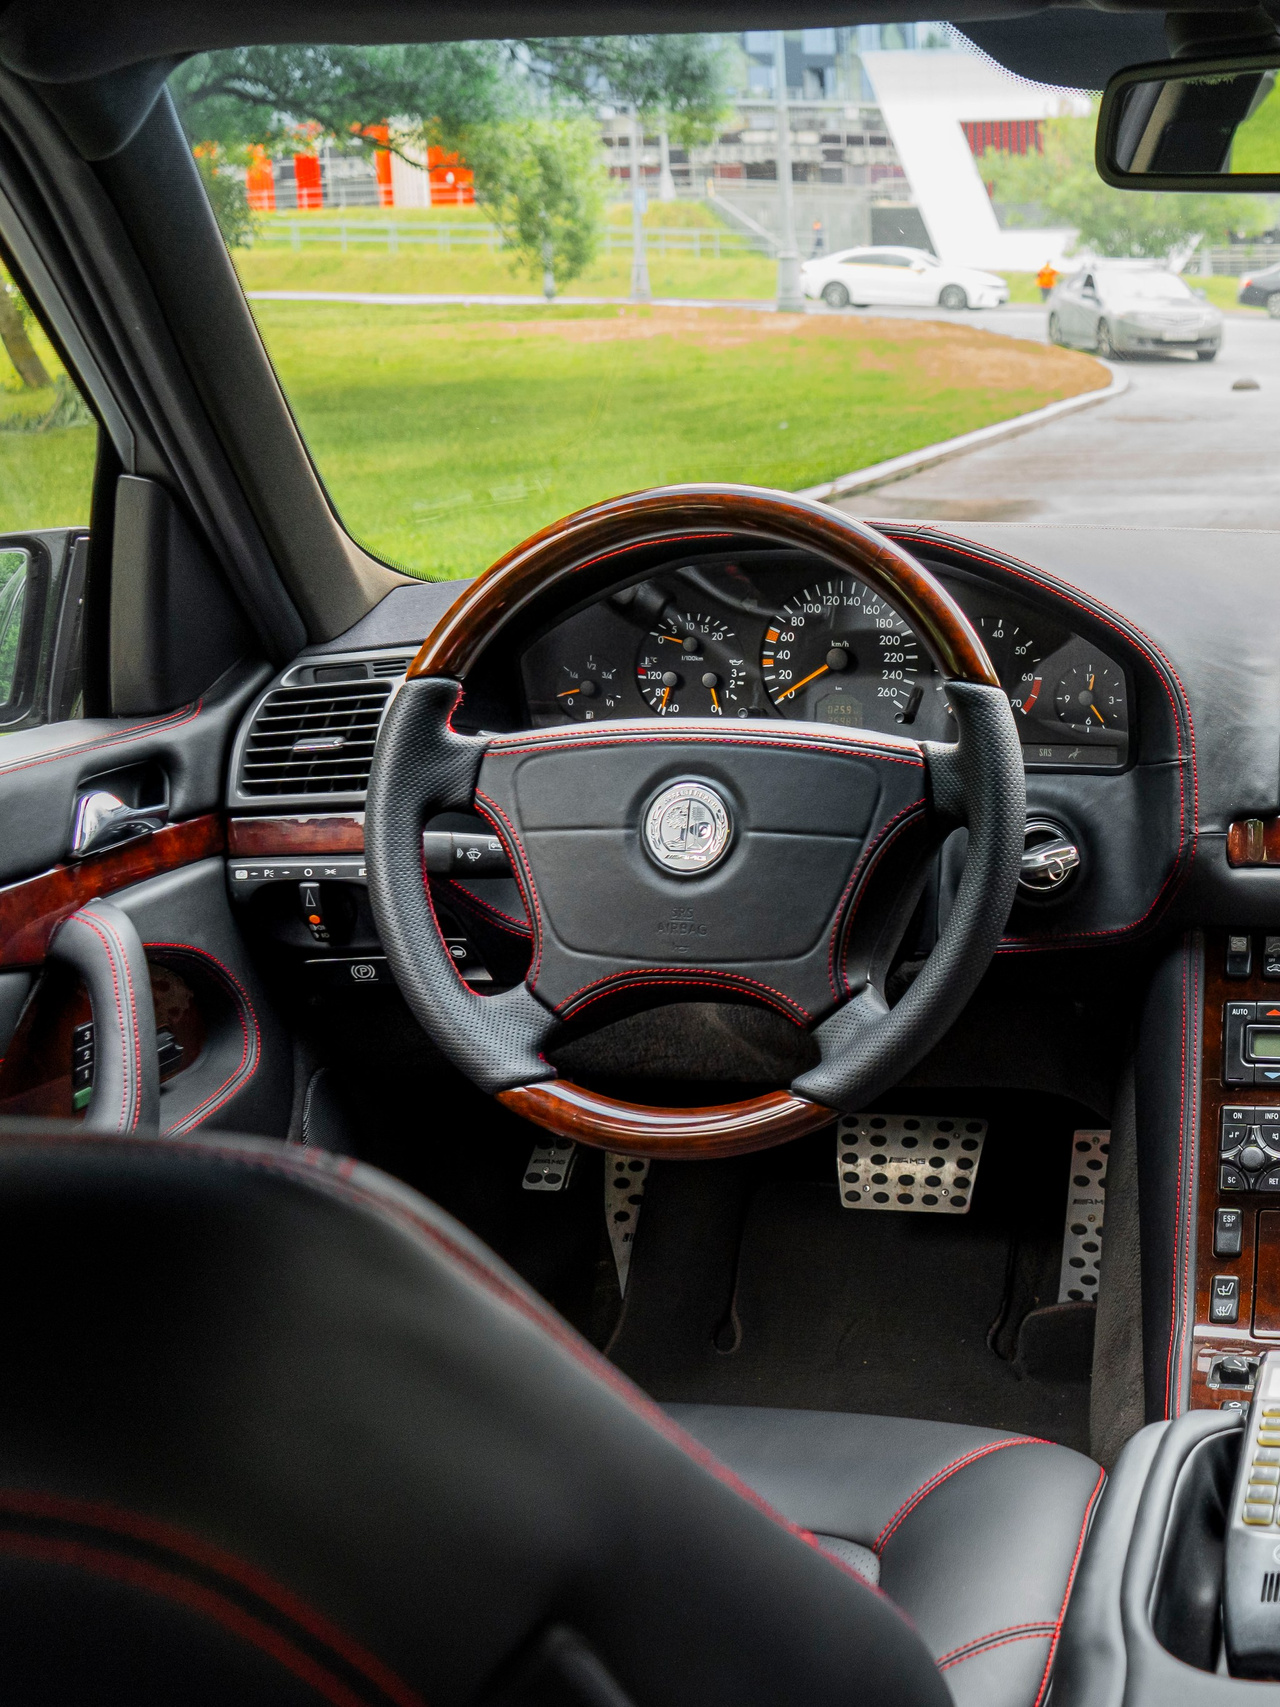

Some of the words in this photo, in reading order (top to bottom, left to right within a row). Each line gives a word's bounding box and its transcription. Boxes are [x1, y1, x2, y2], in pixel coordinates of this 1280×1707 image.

[823, 596, 840, 606] 120
[843, 597, 861, 607] 140
[803, 603, 821, 614] 100
[863, 606, 880, 615] 160
[686, 622, 695, 631] 10
[791, 617, 805, 627] 80
[876, 618, 893, 629] 180
[672, 625, 677, 634] 5
[700, 625, 709, 634] 15
[992, 629, 1004, 639] 40
[658, 635, 664, 645] 0
[712, 632, 723, 641] 20
[780, 632, 795, 643] 60
[879, 635, 900, 646] 200
[831, 640, 849, 648] km/h
[777, 649, 791, 660] 40
[1015, 647, 1027, 656] 50
[884, 652, 904, 663] 220
[648, 671, 662, 680] 120
[732, 669, 737, 677] 3
[779, 669, 793, 680] 20
[882, 670, 903, 681] 240
[1022, 673, 1033, 682] 60
[1086, 673, 1094, 682] 12
[730, 680, 735, 688] 2
[655, 687, 666, 697] 80
[726, 690, 729, 699] 1
[788, 689, 795, 699] 0
[878, 687, 898, 698] 260
[568, 698, 574, 706] 0
[1065, 695, 1071, 703] 9
[1109, 697, 1115, 705] 3
[667, 704, 679, 713] 40
[711, 704, 718, 713] 0
[1011, 700, 1023, 708] 70
[657, 922, 708, 936] AIRBAG
[84, 1031, 91, 1040] 3
[84, 1050, 90, 1060] 2
[84, 1069, 89, 1079] 1
